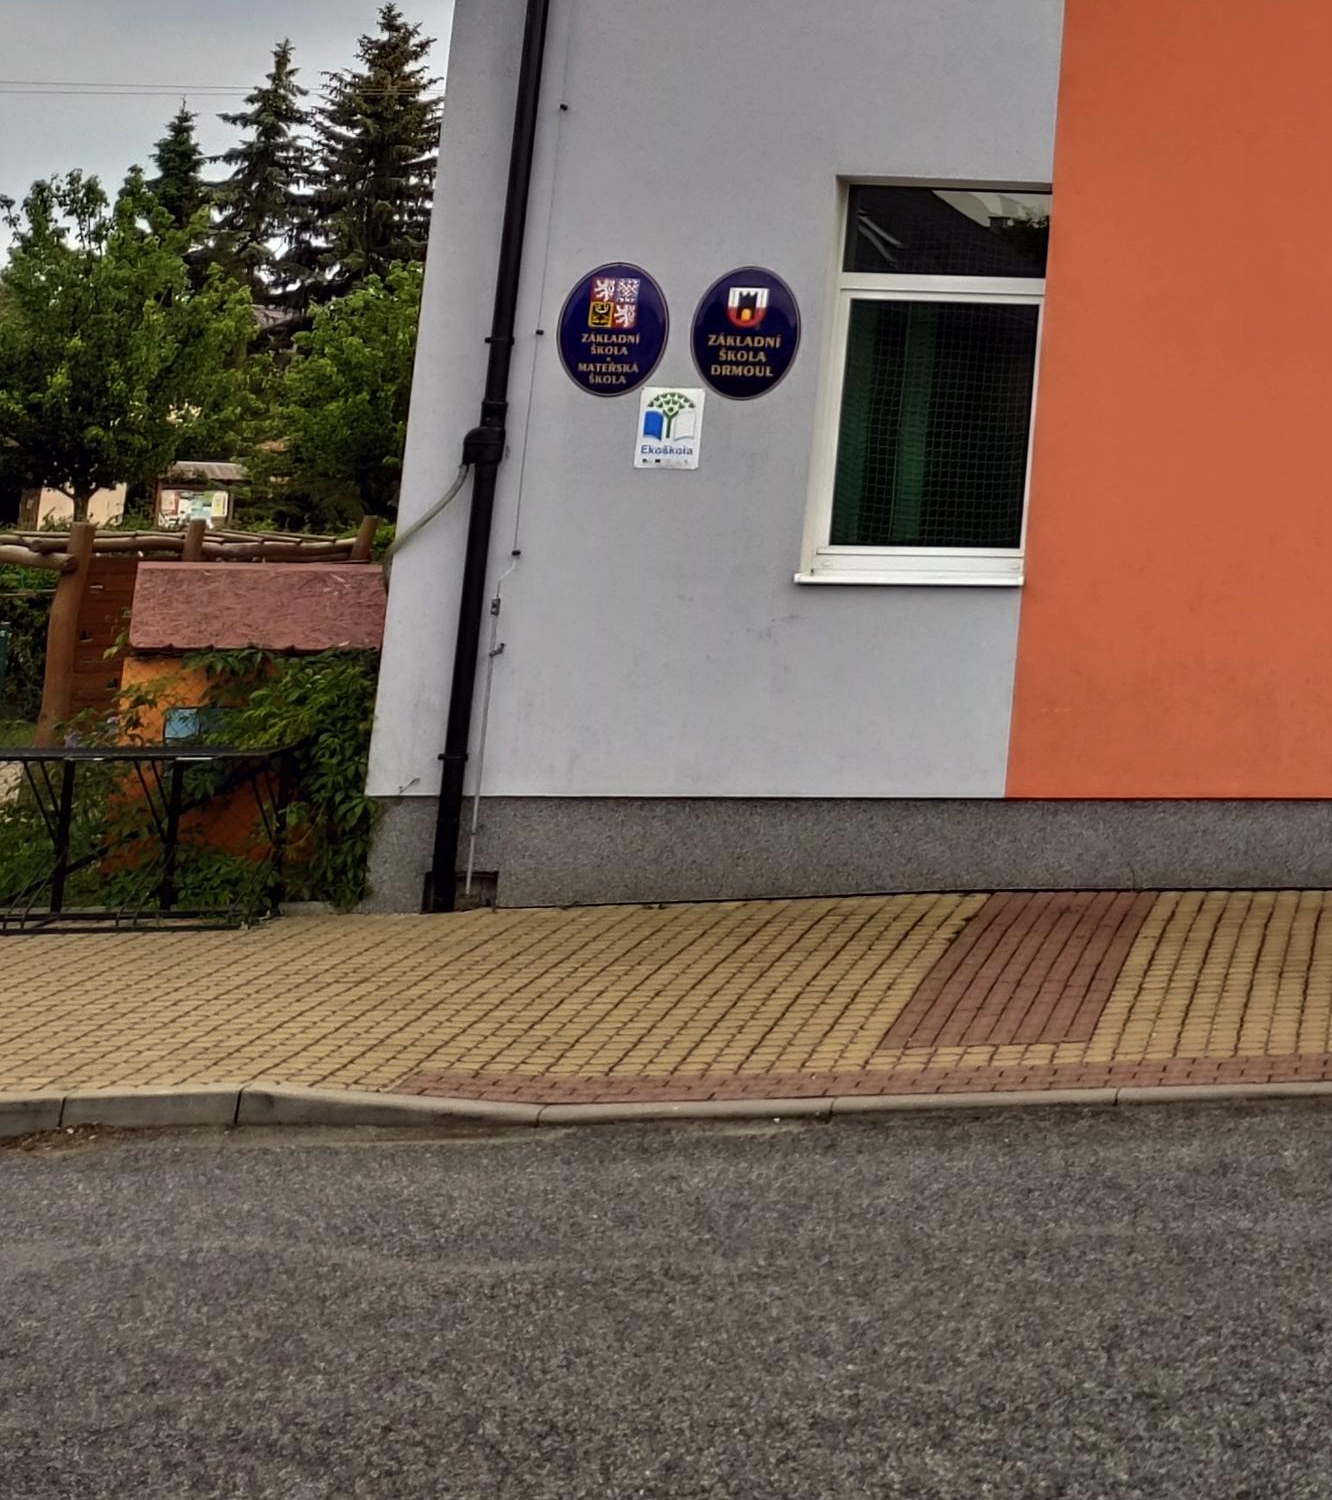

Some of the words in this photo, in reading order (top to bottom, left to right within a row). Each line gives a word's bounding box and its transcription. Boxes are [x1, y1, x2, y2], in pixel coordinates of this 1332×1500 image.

[581, 331, 640, 345] ZÁKLADNÍ
[707, 332, 782, 349] ZÁKLADNÍ
[591, 343, 628, 355] ŠKOLA
[719, 347, 767, 363] ŠKOLA
[577, 361, 640, 373] MATEŘSKÁ
[711, 364, 774, 377] DRMOUL
[589, 372, 627, 384] ŠKOLA
